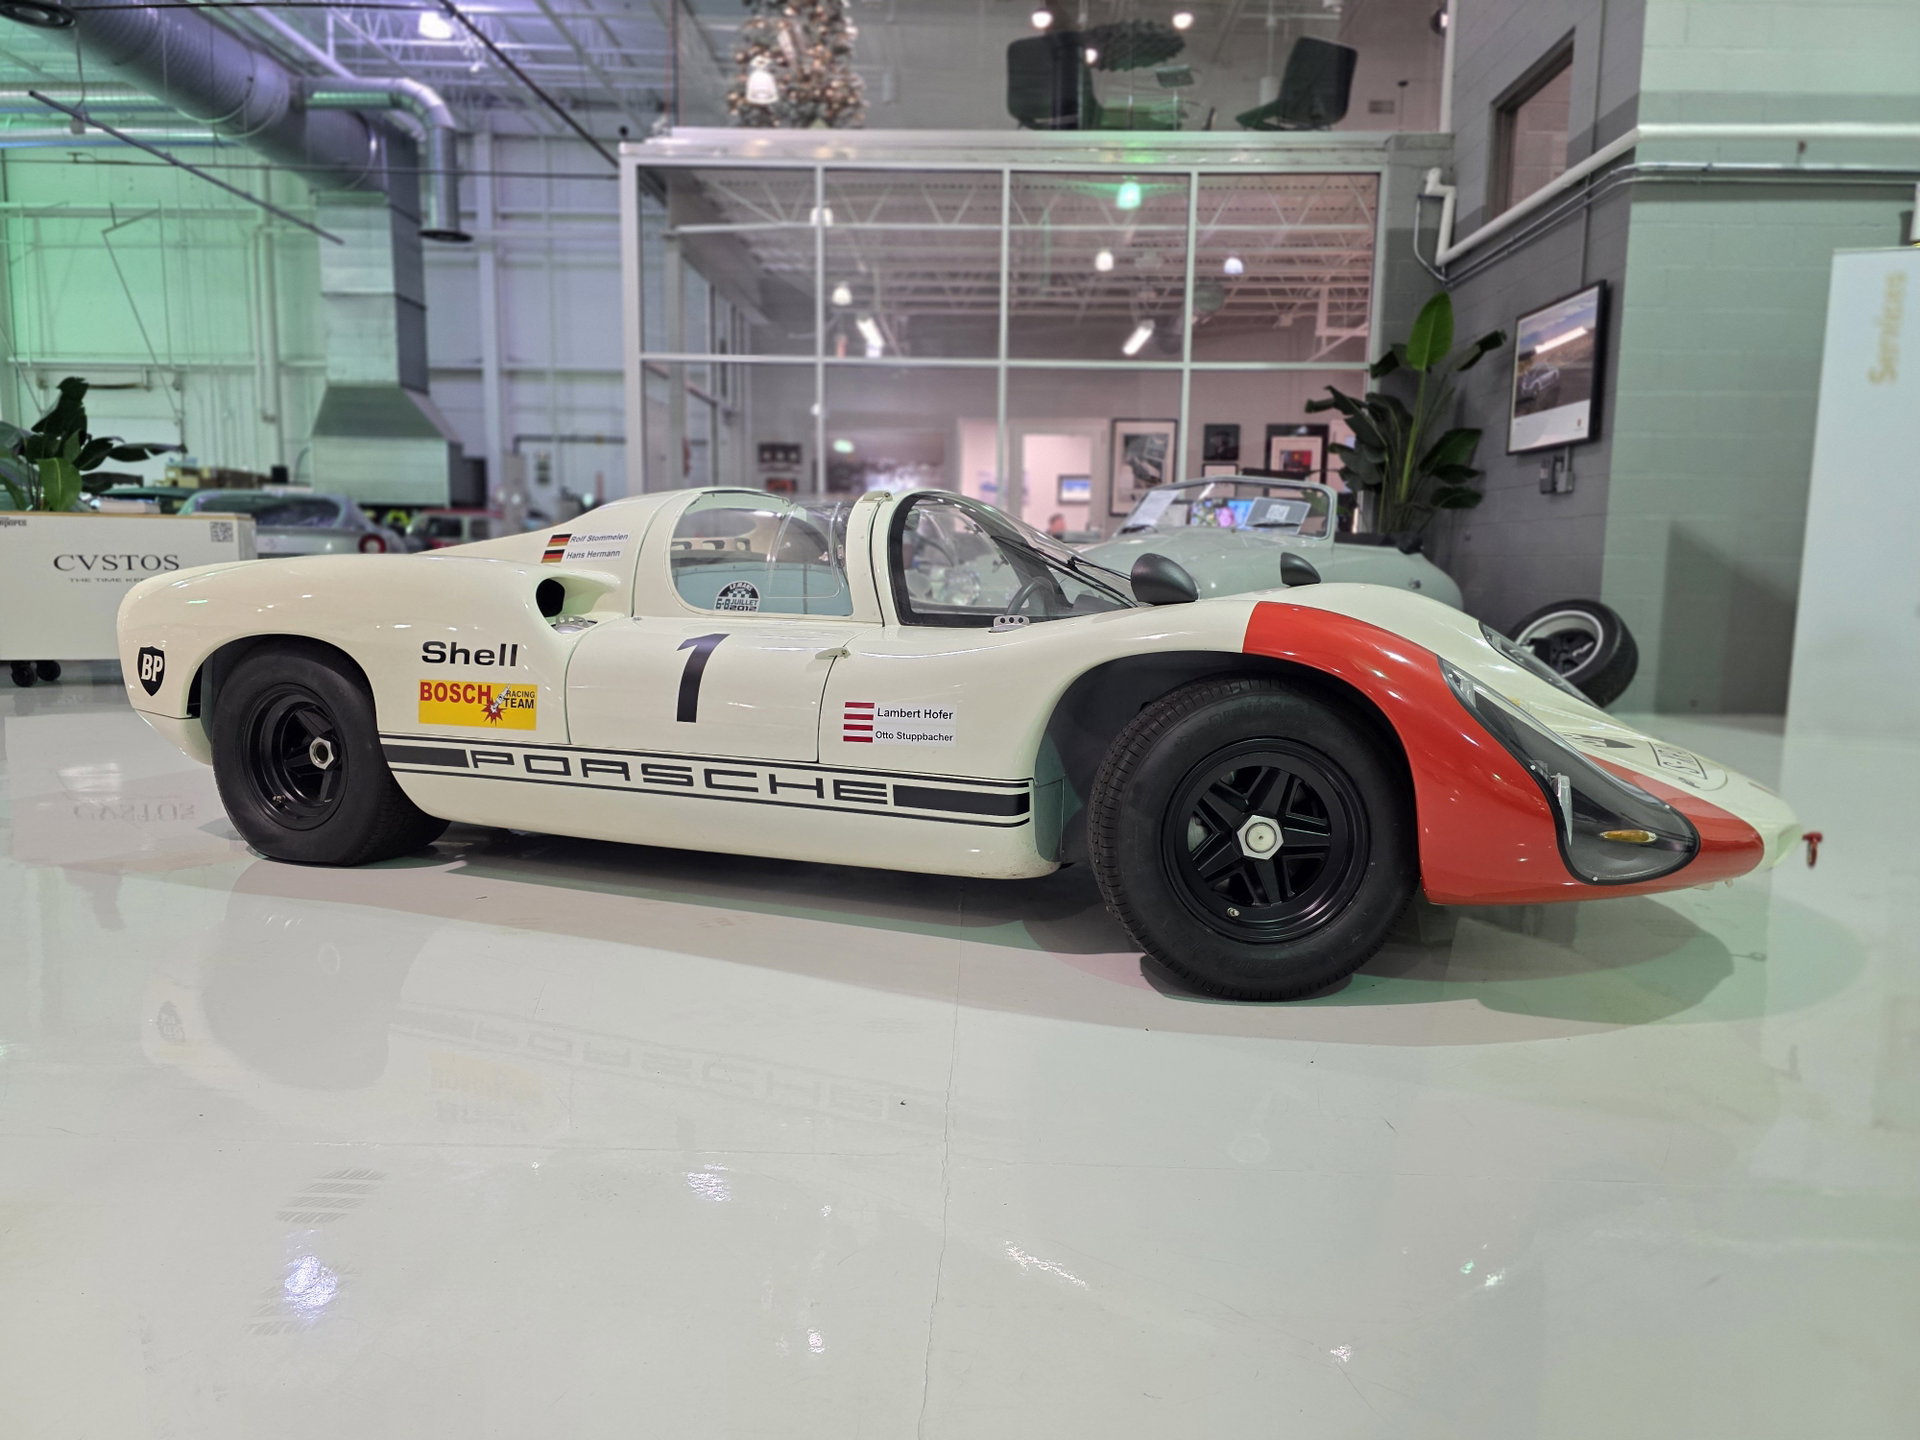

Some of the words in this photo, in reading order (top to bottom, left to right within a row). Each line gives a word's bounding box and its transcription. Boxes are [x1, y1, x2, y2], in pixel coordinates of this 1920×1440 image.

[570, 535, 587, 543] Rolf
[587, 533, 629, 542] Stommelen
[586, 550, 621, 558] Hermann
[53, 554, 180, 571] CVSTOS
[421, 640, 519, 667] Shell
[141, 653, 164, 682] BP
[676, 633, 731, 723] 1
[419, 681, 492, 704] BOSCH
[505, 689, 536, 698] RACING
[503, 697, 535, 709] TEAM
[877, 707, 921, 719] Lambert
[923, 709, 954, 720] Hofer
[875, 730, 894, 740] Otto
[896, 731, 953, 742] Stuppbacher
[469, 749, 889, 805] PORSCHE
